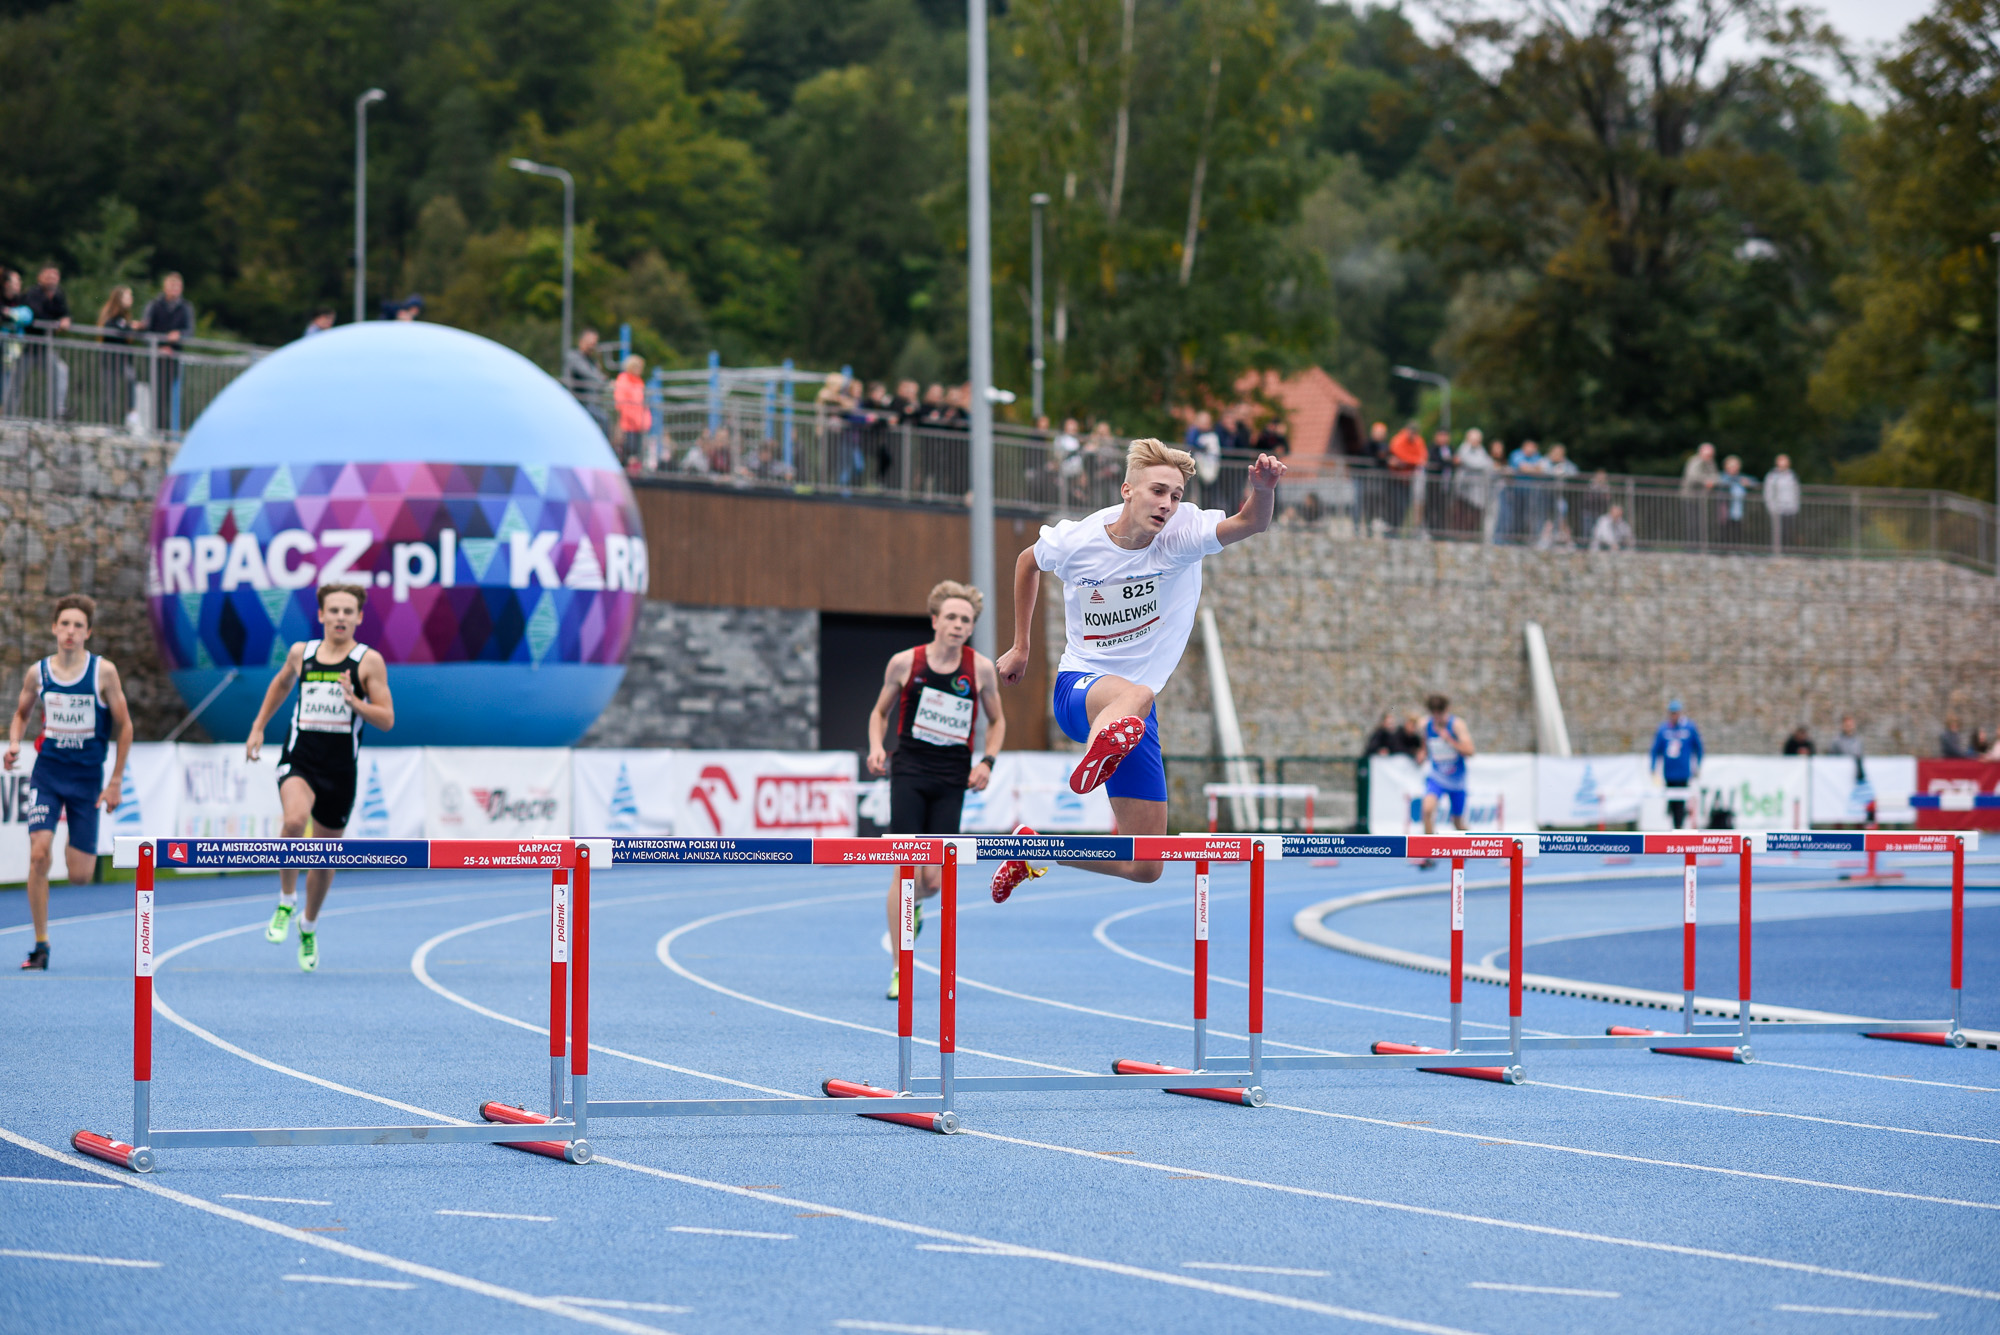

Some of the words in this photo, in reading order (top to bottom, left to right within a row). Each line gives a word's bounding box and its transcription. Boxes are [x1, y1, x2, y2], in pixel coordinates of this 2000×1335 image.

[1123, 581, 1154, 599] 825
[1084, 600, 1157, 627] KOWALEWSKI
[1096, 631, 1133, 648] KARPACZ
[1135, 626, 1151, 639] 2021
[955, 701, 971, 712] 59
[920, 708, 969, 729] PORWOLIK
[976, 838, 1020, 847] STRZOSTWA
[1022, 839, 1049, 847] POLSKI
[1050, 839, 1065, 847] U16
[1307, 837, 1331, 845] POLSKI
[1331, 837, 1345, 845] U16
[1471, 839, 1504, 848] KARPACZ
[1552, 835, 1575, 843] POLSKI
[1702, 836, 1733, 845] KARPACZ
[196, 843, 220, 852] PZLA
[222, 843, 289, 852] MISTRZOSTWA
[291, 843, 323, 852] POLSKI
[326, 843, 343, 852] U16
[519, 843, 562, 853] KARPACZ
[611, 840, 626, 849] ZLA
[628, 840, 687, 849] MISTRZOSTWA
[689, 841, 718, 849] POLSKI
[720, 841, 736, 849] U16
[892, 842, 931, 850] KARPACZ
[1205, 841, 1241, 849] KARPACZ
[1016, 849, 1051, 857] JANUSZA
[1052, 848, 1117, 859] KUSOCIŃSKIEGO
[1160, 851, 1183, 859] 25-26
[1184, 849, 1222, 859] WRZEŚNIA
[1302, 846, 1333, 854] JANUSZA
[1334, 845, 1392, 855] KUSOCIŃSKIEGO
[1431, 848, 1451, 856] 25-26
[1451, 847, 1486, 857] WRZEŚNIA
[1486, 848, 1503, 857] 2021
[196, 854, 225, 864] MAŁY
[227, 855, 281, 864] MEMORIAŁ
[284, 855, 327, 864] JANUSZA
[329, 853, 408, 865] KUSOCIŃSKIEGO
[464, 856, 490, 865] 25-26
[492, 854, 539, 865] WRZEŚNIA
[540, 855, 561, 867] 2021
[633, 851, 680, 860] MEMORIAŁ
[683, 851, 721, 860] JANUSZA
[723, 850, 794, 861] KUSOCIŃSKIEGO
[843, 852, 867, 861] 25-26
[868, 851, 909, 861] WRZEŚNIA
[911, 853, 930, 861] 2021
[1199, 890, 1207, 923] polanik
[904, 896, 913, 932] polanik
[556, 903, 566, 943] polanik
[140, 911, 151, 955] polanik
